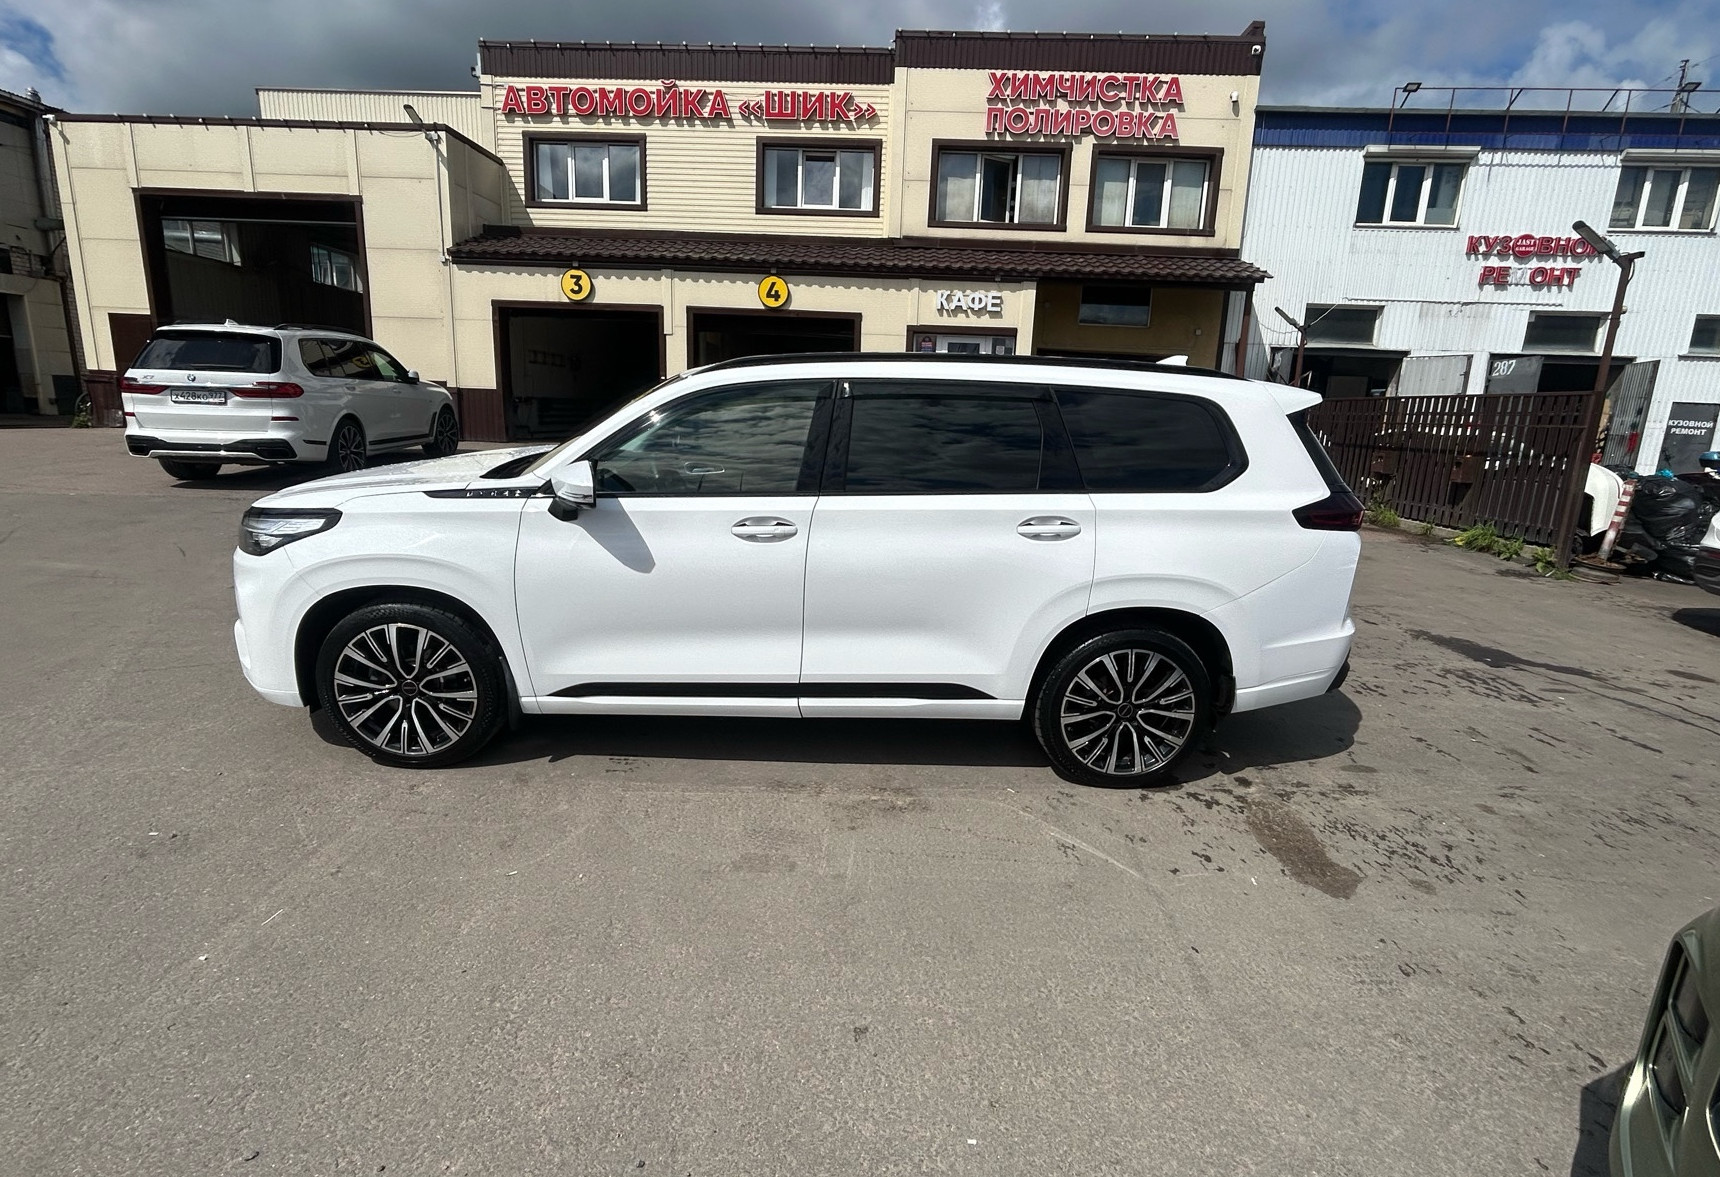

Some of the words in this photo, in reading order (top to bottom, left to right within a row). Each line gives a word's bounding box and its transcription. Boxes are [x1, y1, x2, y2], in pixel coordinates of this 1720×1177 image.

[988, 72, 1183, 103] ХИМЧИСТКА
[501, 79, 731, 118] АВТОМОЙКА
[985, 107, 1179, 139] ПОЛИРОВКА
[569, 274, 583, 295] 3
[765, 281, 781, 302] 4
[936, 289, 1001, 312] КАФЕ
[1491, 359, 1517, 377] 287
[1668, 419, 1715, 428] КУЗОВНОЙ
[1670, 427, 1707, 436] РЕМОНТ
